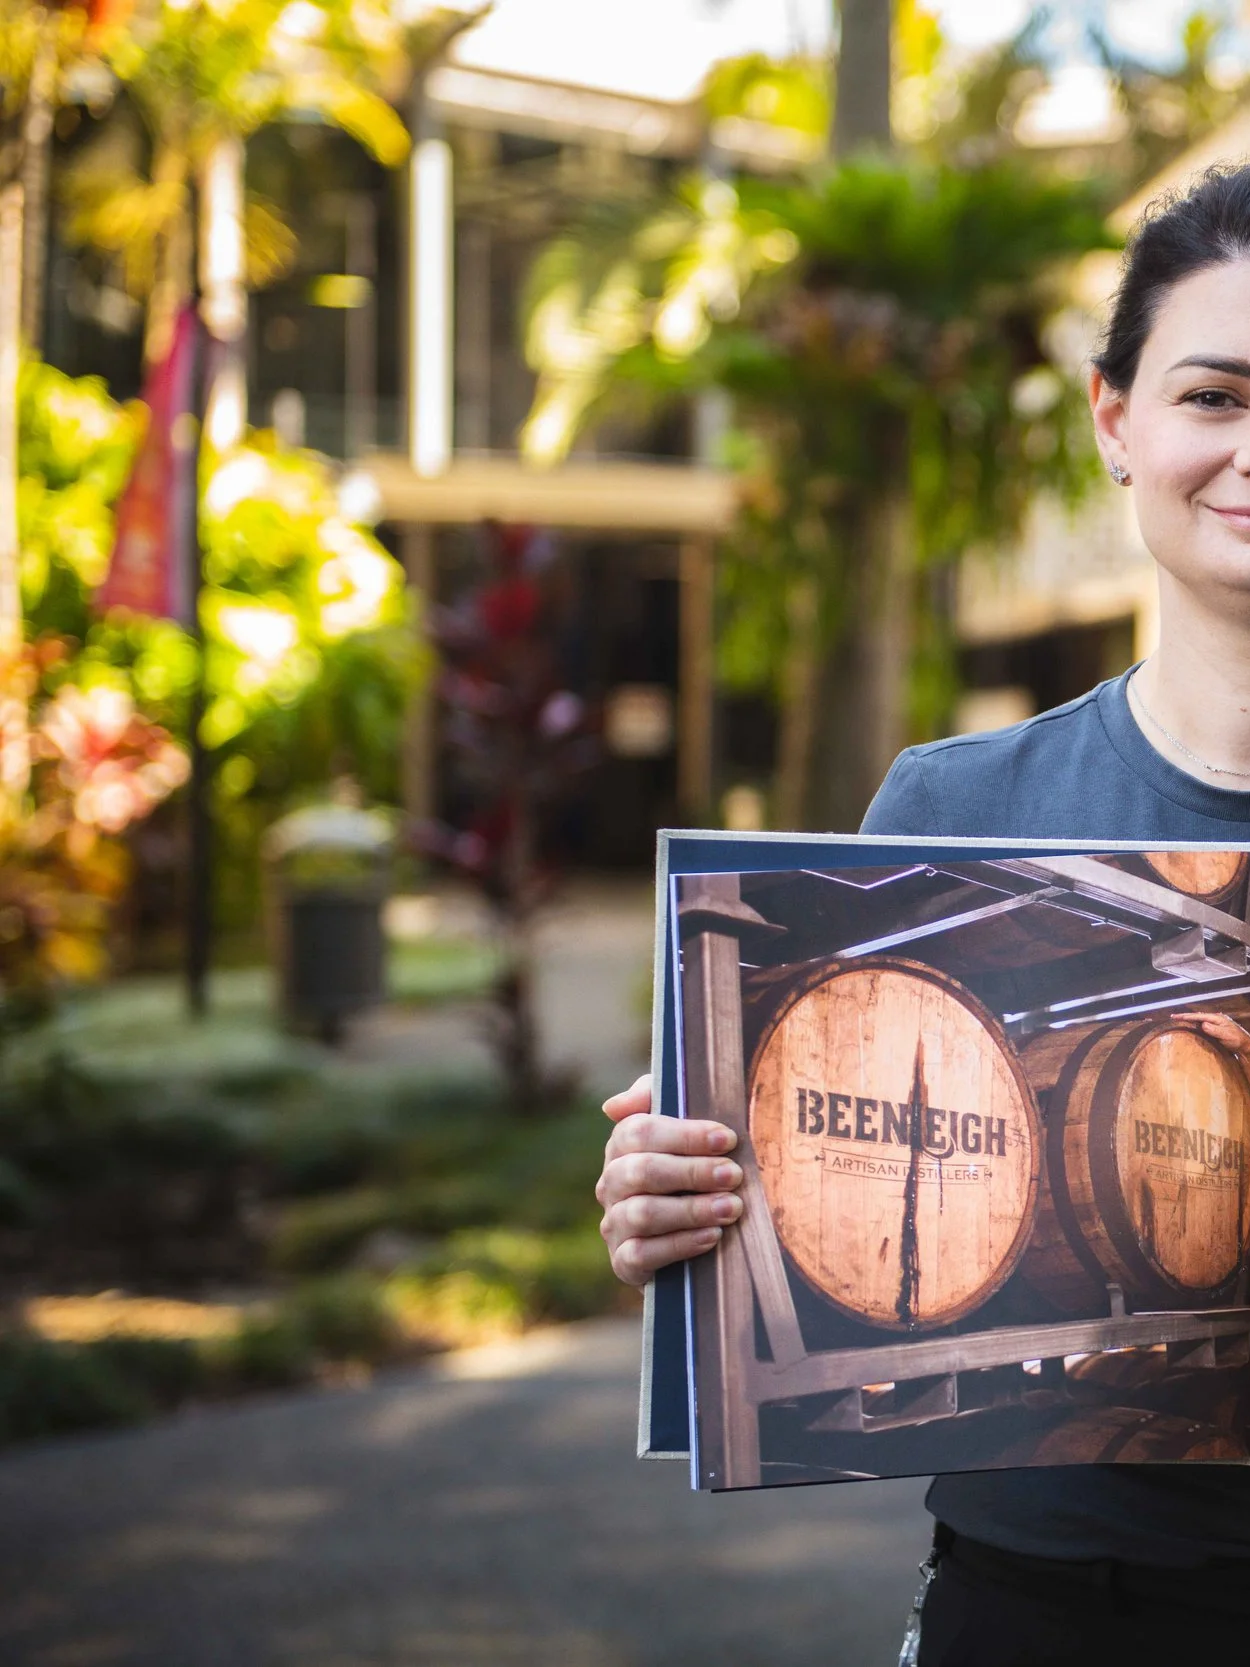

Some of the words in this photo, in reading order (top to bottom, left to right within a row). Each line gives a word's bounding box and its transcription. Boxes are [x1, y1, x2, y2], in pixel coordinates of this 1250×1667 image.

[796, 1087, 1007, 1159] BEENLEIGH
[1135, 1119, 1245, 1172] BEENLEIGH
[832, 1156, 898, 1175] ARTISAN
[903, 1164, 979, 1181] STILLERS
